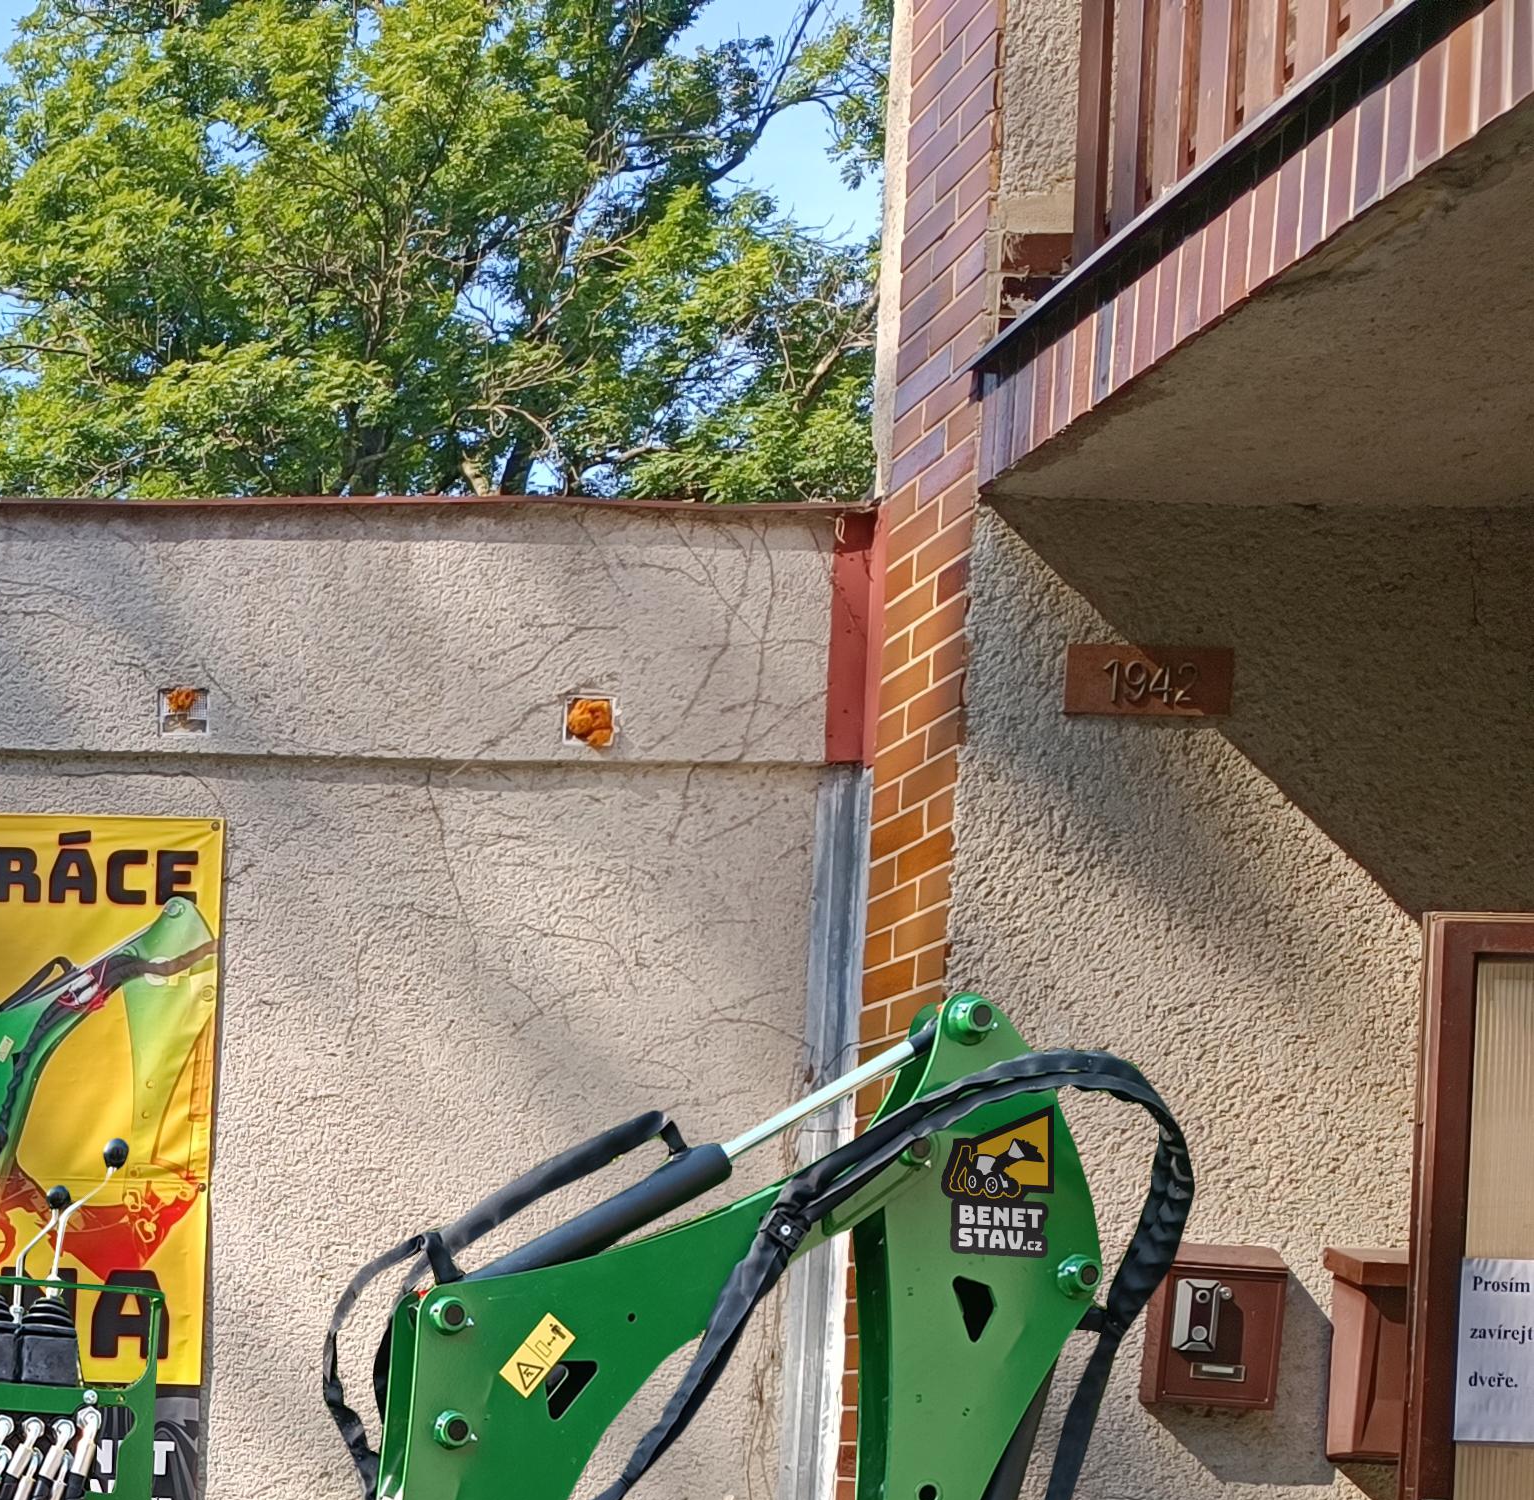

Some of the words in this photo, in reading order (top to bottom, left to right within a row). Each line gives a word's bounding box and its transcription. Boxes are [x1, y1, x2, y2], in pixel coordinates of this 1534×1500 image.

[1102, 658, 1200, 704] 1942
[958, 1204, 1043, 1229] BENET
[1472, 1275, 1531, 1293] Prosím
[1468, 1371, 1519, 1388] dveře.
